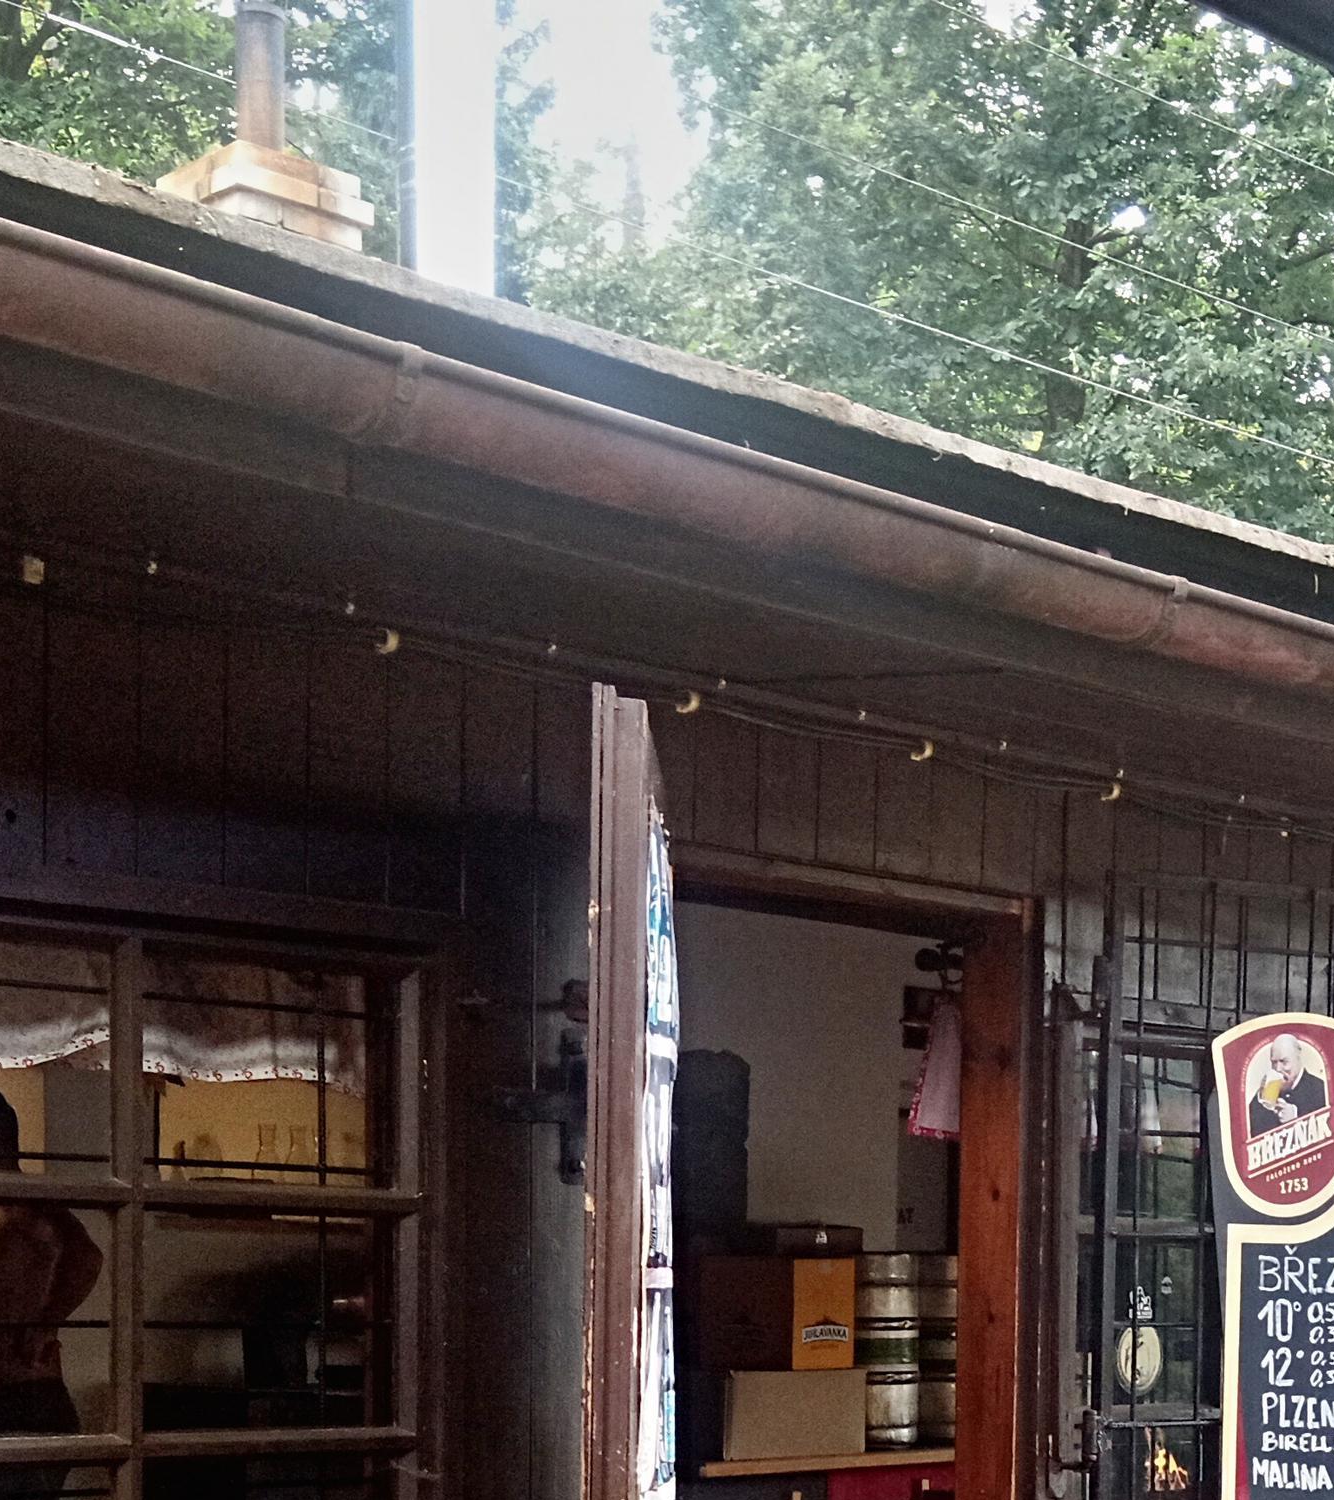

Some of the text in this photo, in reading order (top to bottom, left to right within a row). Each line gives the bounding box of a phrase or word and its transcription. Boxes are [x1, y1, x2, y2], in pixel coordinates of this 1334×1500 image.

[1279, 1177, 1309, 1195] 1753
[1257, 1298, 1302, 1342] 10°
[1260, 1347, 1305, 1387] 12°
[1261, 1431, 1333, 1453] BIRELL
